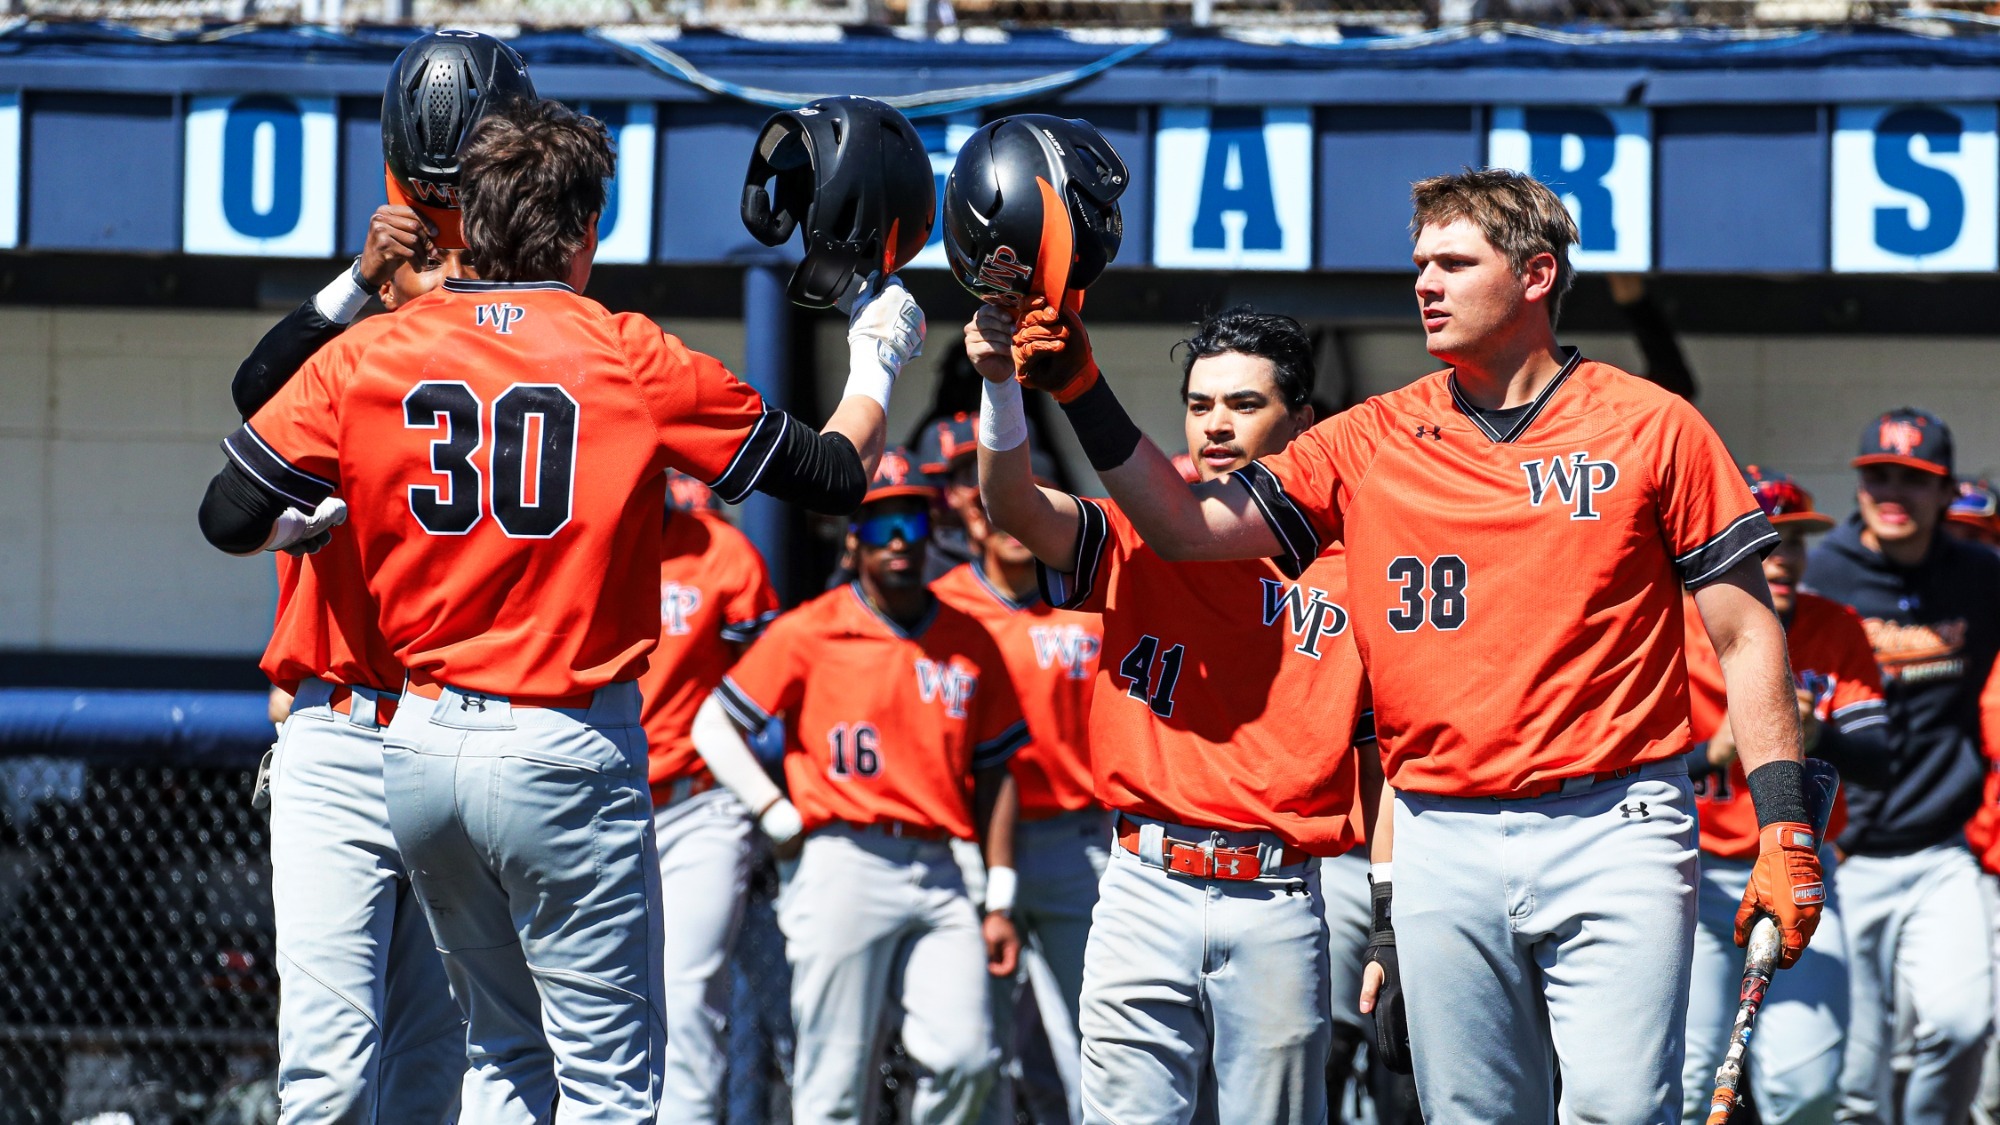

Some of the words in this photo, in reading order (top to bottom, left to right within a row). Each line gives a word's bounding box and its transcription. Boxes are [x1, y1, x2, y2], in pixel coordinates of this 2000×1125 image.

[1042, 129, 1066, 156] EASTON
[1191, 106, 1283, 251] A
[1873, 103, 1965, 257] S
[978, 245, 1033, 290] WP
[476, 303, 525, 334] WP
[402, 380, 580, 539] 30
[1520, 451, 1619, 520] WP
[661, 581, 702, 636] P
[1259, 577, 1349, 660] WP
[1387, 554, 1468, 633] 38
[1028, 624, 1101, 680] WP
[1119, 634, 1185, 718] 41
[914, 658, 978, 720] WP
[827, 721, 886, 781] 16
